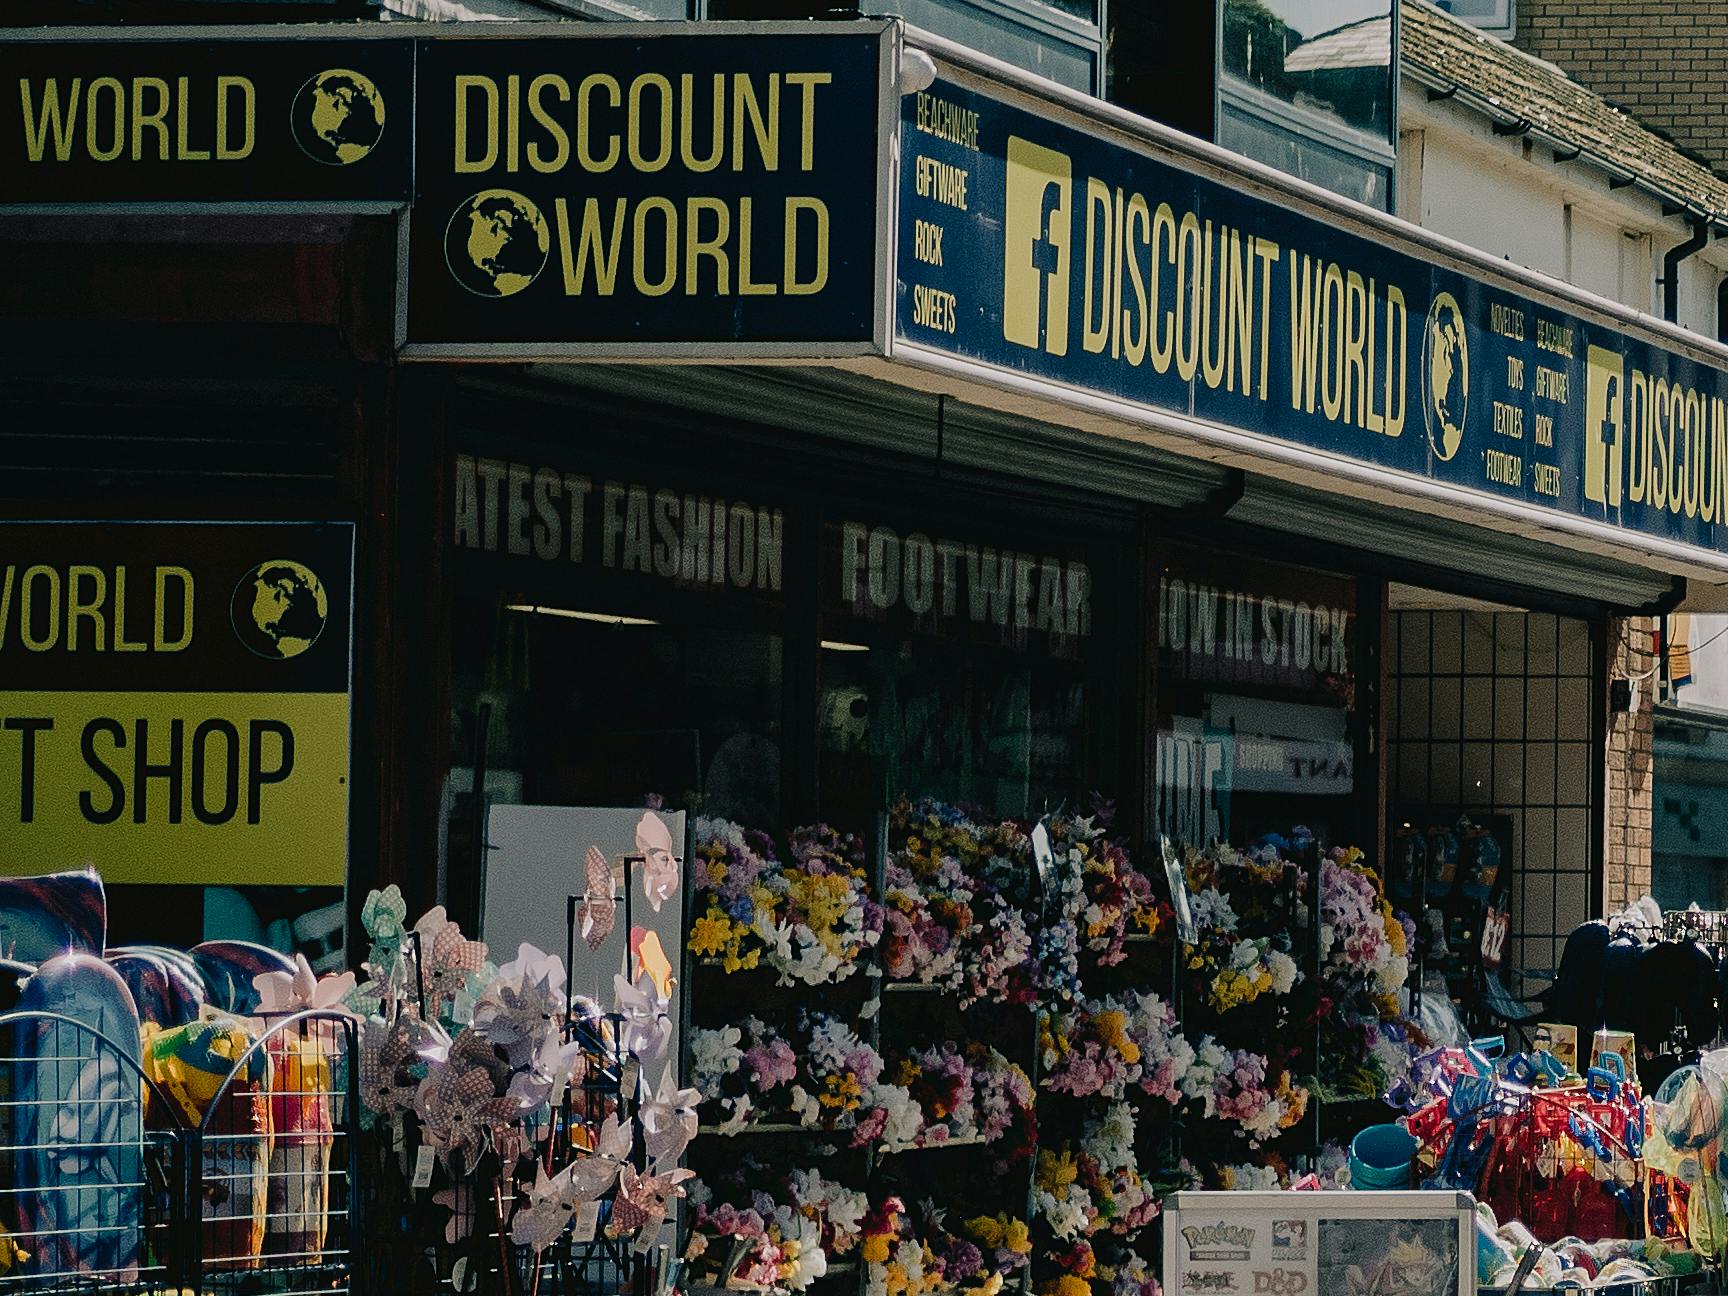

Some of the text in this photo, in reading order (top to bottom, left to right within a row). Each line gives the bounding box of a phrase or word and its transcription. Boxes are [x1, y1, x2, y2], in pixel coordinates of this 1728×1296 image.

[20, 77, 256, 162] WORLD
[455, 73, 831, 174] DISCOUNT
[917, 92, 979, 151] BEACHWARE
[916, 155, 968, 210] GIFTWARE
[555, 196, 830, 298] WORLD
[915, 219, 943, 266] ROCK
[914, 284, 956, 333] SWEETS
[1083, 176, 1407, 437] DISCOUNT WORLD
[1507, 355, 1524, 390] TOYS
[1494, 401, 1523, 439] TEXTILES
[1487, 449, 1521, 487] FOOTWEAR
[1534, 462, 1560, 497] SWEETS
[455, 454, 783, 591] ATEST FASHION
[843, 520, 1092, 635] FOOTWEAR
[1261, 595, 1347, 674] STOCK
[2, 717, 295, 827] T SHOP
